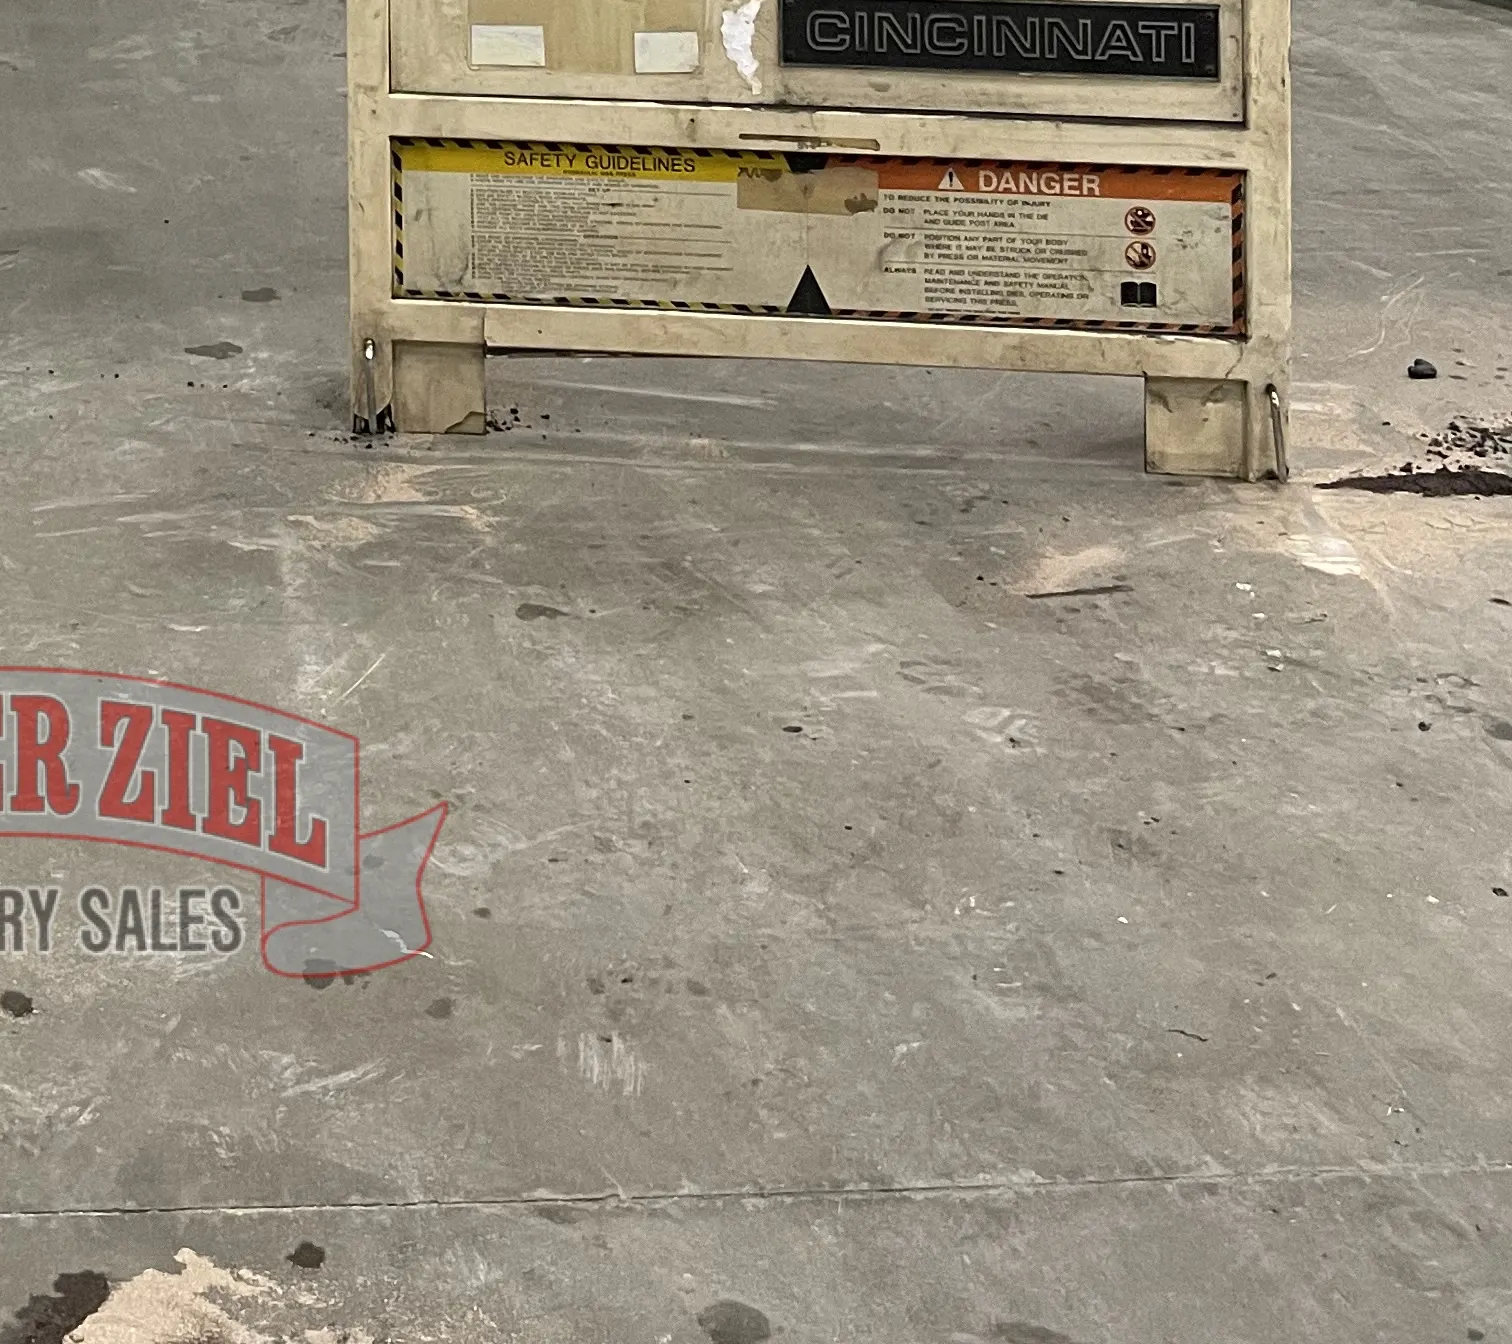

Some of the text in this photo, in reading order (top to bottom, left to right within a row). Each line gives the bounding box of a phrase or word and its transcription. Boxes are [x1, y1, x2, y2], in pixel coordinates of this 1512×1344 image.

[807, 10, 1195, 63] CINCINNATI
[503, 151, 696, 173] SAFETY GUIDELINES
[979, 170, 1101, 196] DANGER
[935, 196, 949, 204] THE
[954, 197, 1004, 206] POSSIBILITY
[952, 209, 975, 217] YOUR
[977, 211, 1005, 219] HANDS
[924, 234, 960, 242] POSITION
[924, 243, 952, 251] WHERE
[1000, 246, 1031, 254] STRUCK
[1050, 248, 1088, 257] CRUSHED
[938, 253, 964, 261] PRESS
[982, 255, 1020, 263] MATERIAL
[924, 268, 945, 276] READ
[968, 270, 1020, 279] UNDERSTAND
[924, 278, 980, 286] MAINTENANCE
[959, 288, 1003, 297] INSTALLING
[1029, 291, 1074, 300] OPERATING
[925, 296, 966, 304] SERVICING
[970, 297, 987, 305] THIS
